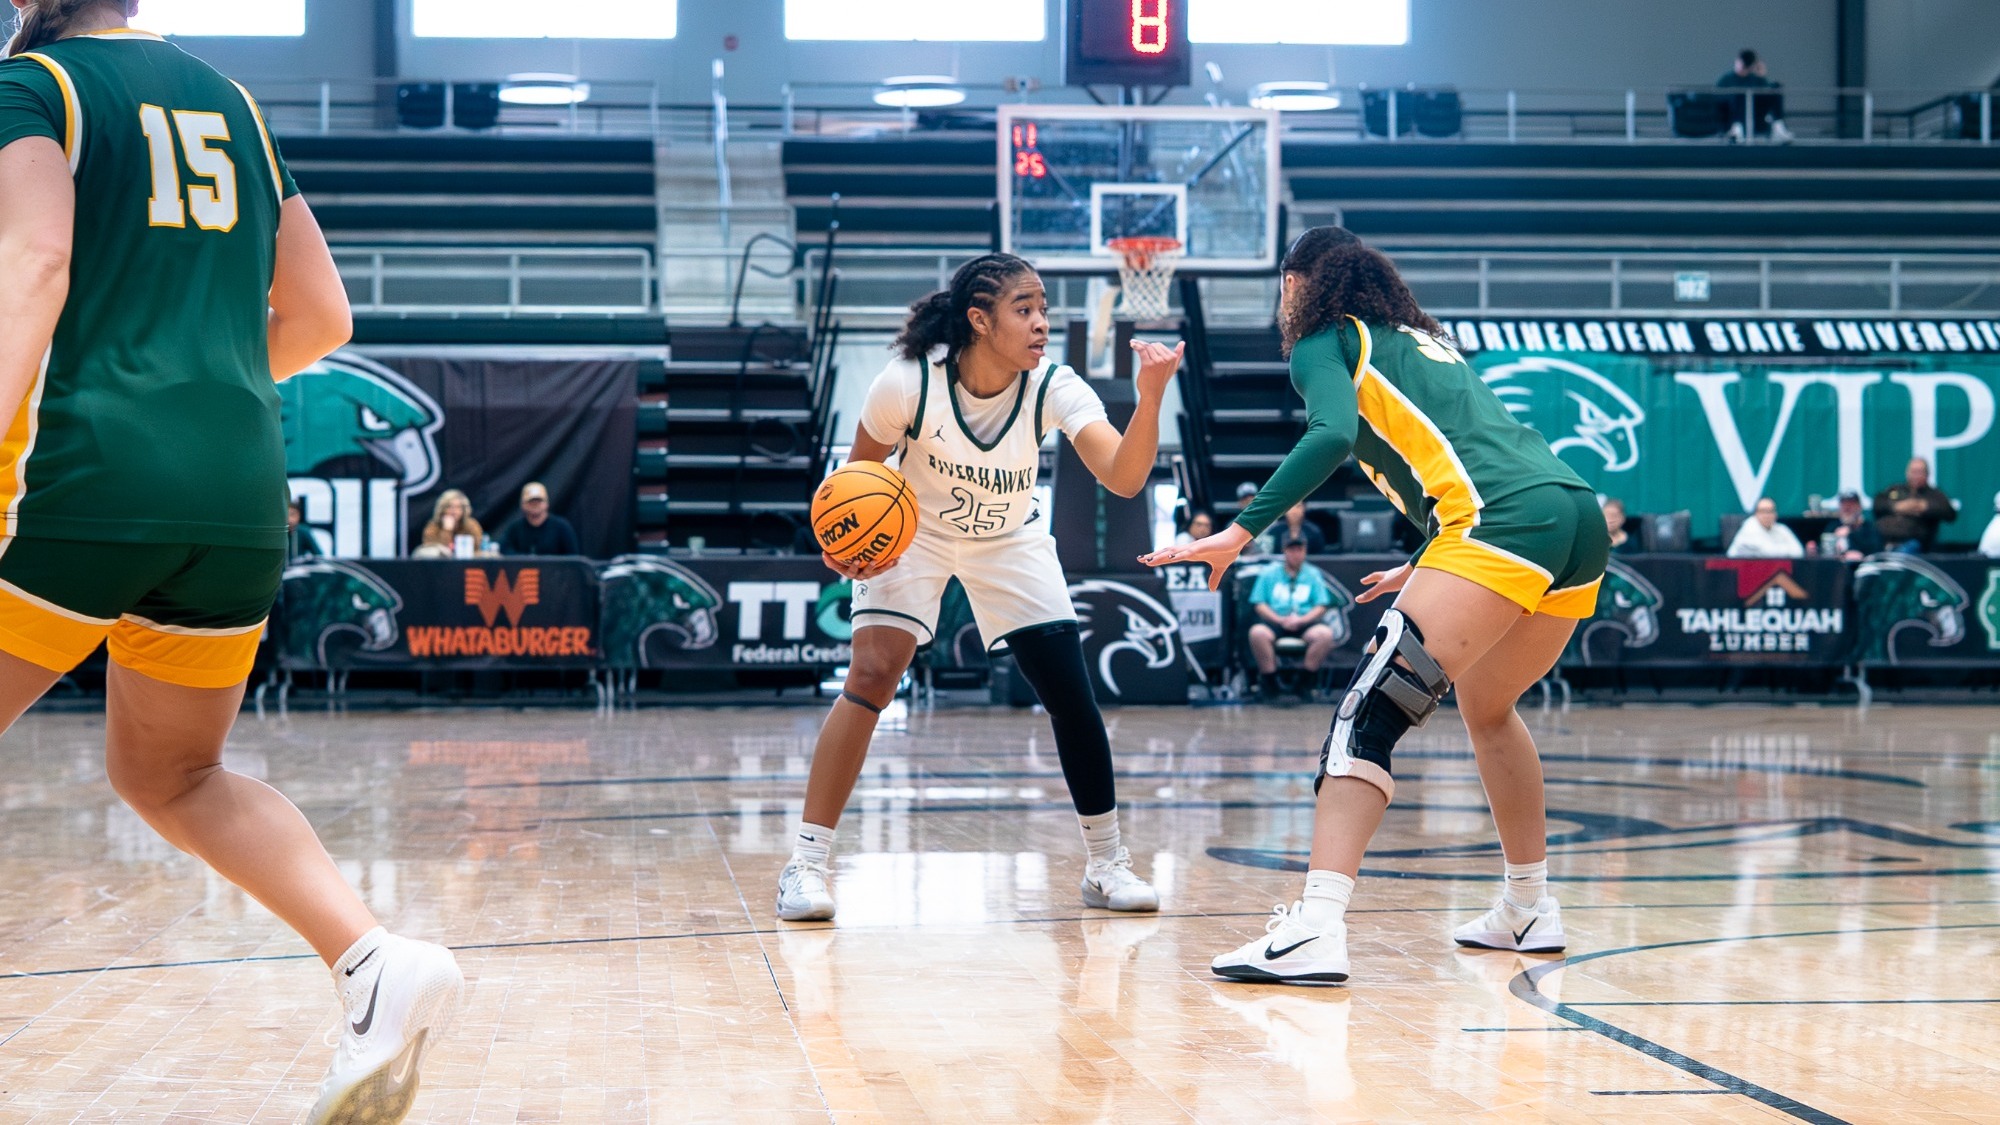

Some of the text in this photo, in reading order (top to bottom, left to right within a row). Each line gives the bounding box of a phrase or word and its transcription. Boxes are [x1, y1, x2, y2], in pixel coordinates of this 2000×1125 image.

[139, 102, 239, 233] 15
[1704, 321, 1805, 352] STATE
[1674, 371, 1996, 514] VIP
[928, 453, 1033, 495] RIVERHAWKS
[939, 486, 1010, 536] 25
[819, 512, 860, 547] NCAA
[844, 531, 894, 566] Wils
[1676, 608, 1843, 633] TAHLEQUAH
[406, 626, 591, 657] WHATABURGER
[732, 643, 800, 663] Federal
[1709, 633, 1810, 651] LUMBER
